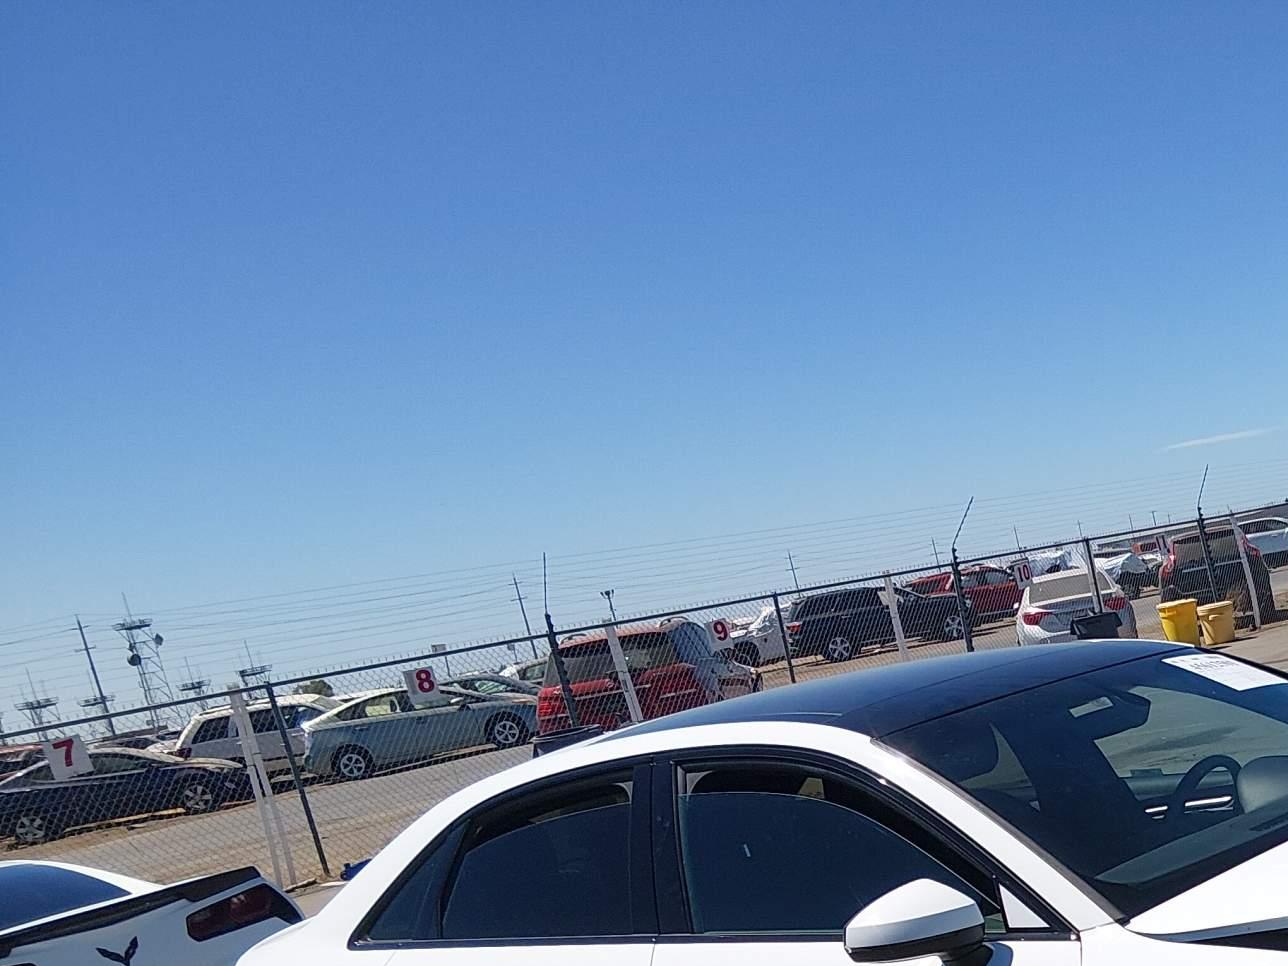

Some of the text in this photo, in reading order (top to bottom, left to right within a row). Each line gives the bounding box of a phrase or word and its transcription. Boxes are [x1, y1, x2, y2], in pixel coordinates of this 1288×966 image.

[1017, 564, 1030, 582] 10
[713, 621, 728, 642] 9
[415, 669, 435, 693] 8
[51, 737, 74, 767] 7
